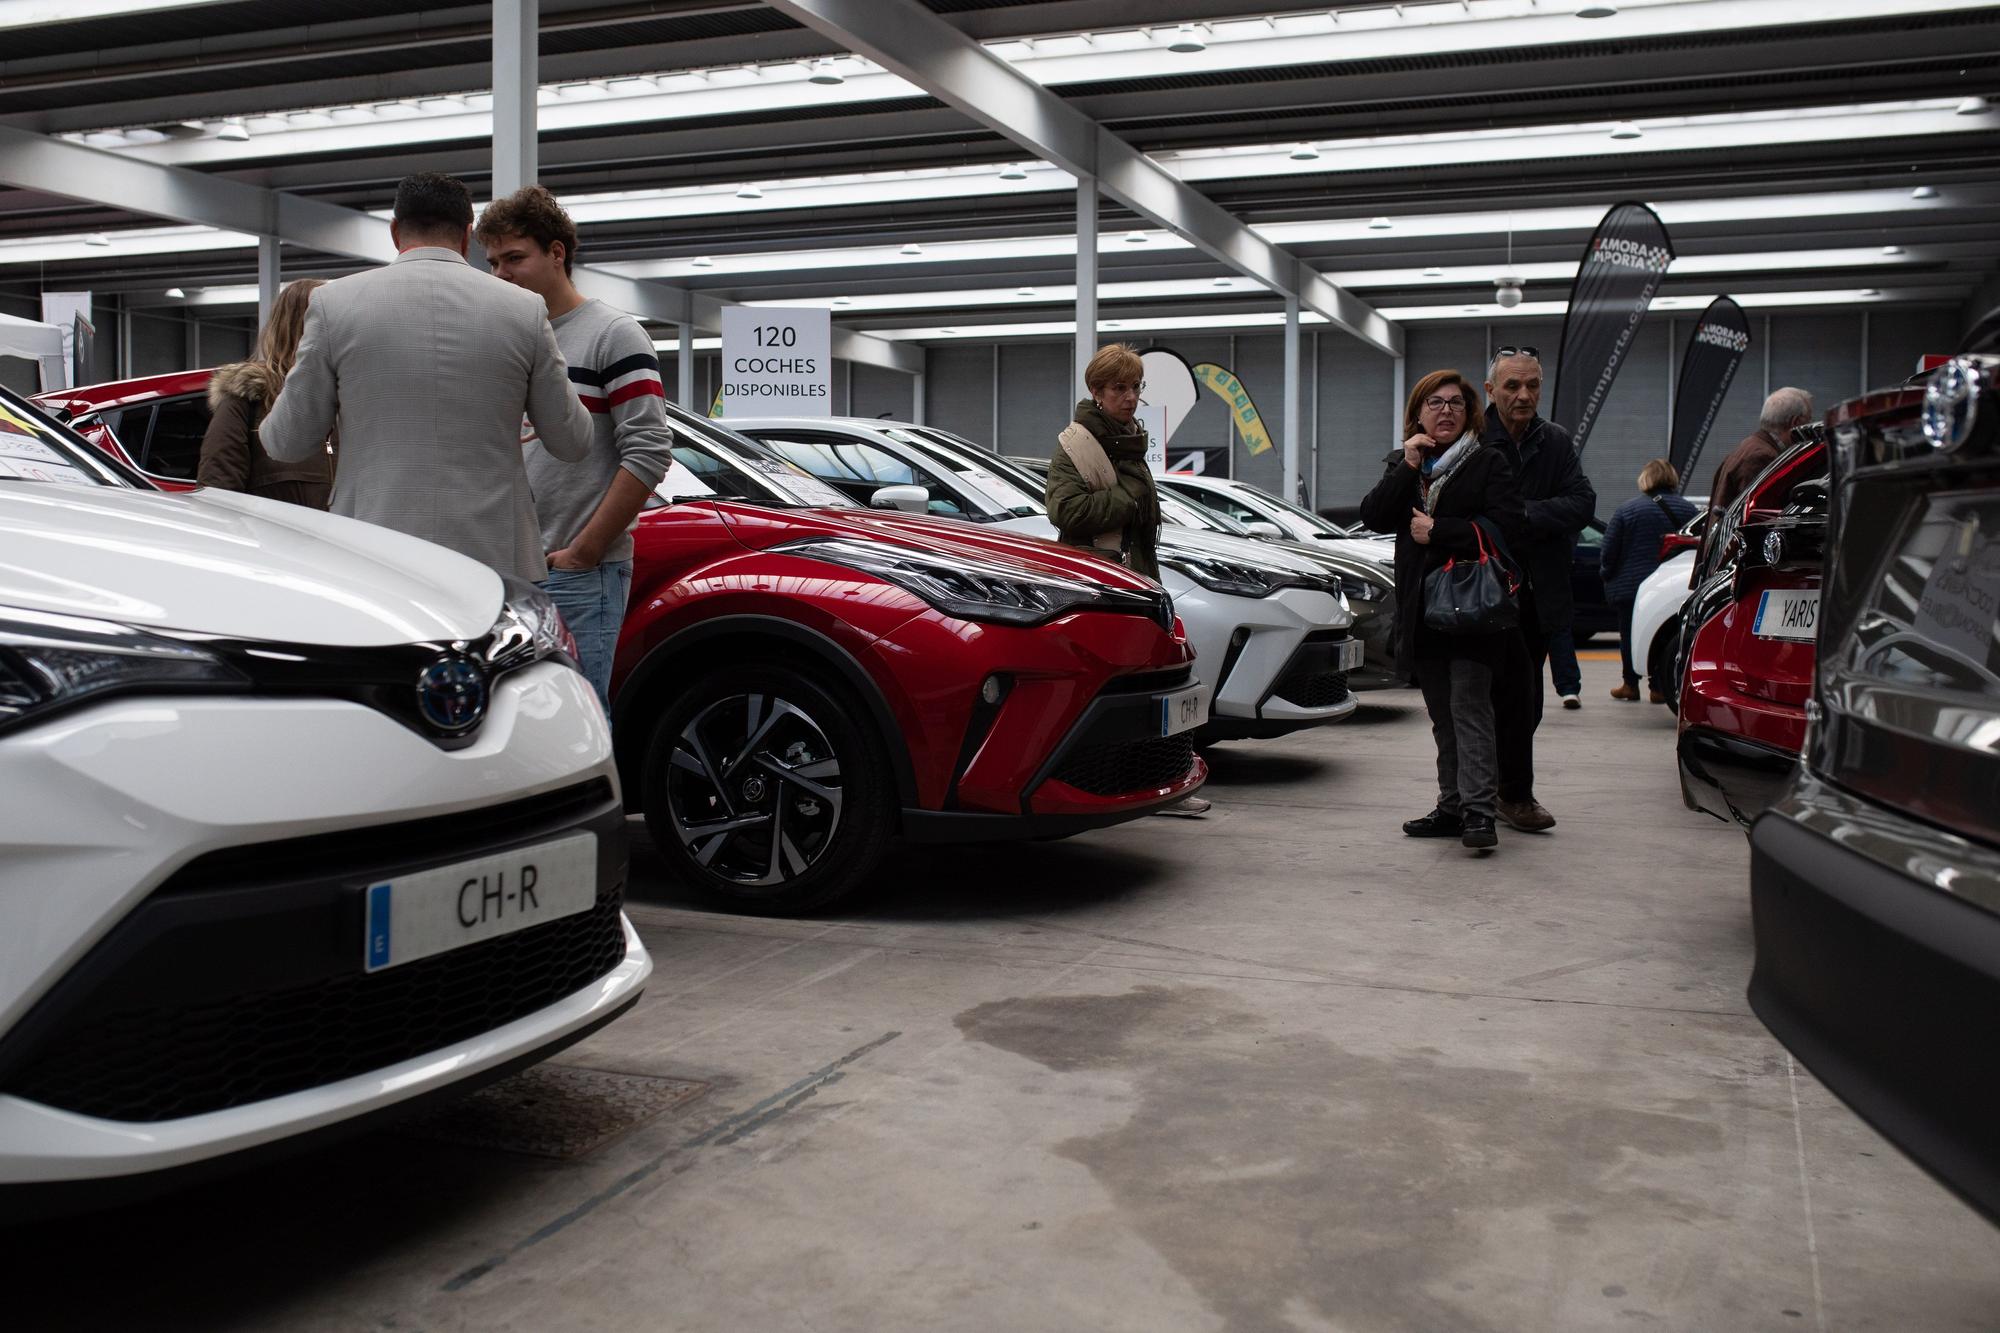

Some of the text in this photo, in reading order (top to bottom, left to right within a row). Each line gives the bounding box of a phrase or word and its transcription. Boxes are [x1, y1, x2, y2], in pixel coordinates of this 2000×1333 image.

[753, 326, 796, 347] 120
[734, 358, 816, 374] COCHES
[724, 383, 827, 397] DISPONIBLES
[1680, 358, 1737, 490] moraimporta.com
[1781, 600, 1818, 628] YARIS
[1181, 696, 1198, 724] CH-R
[457, 864, 539, 929] CH-R
